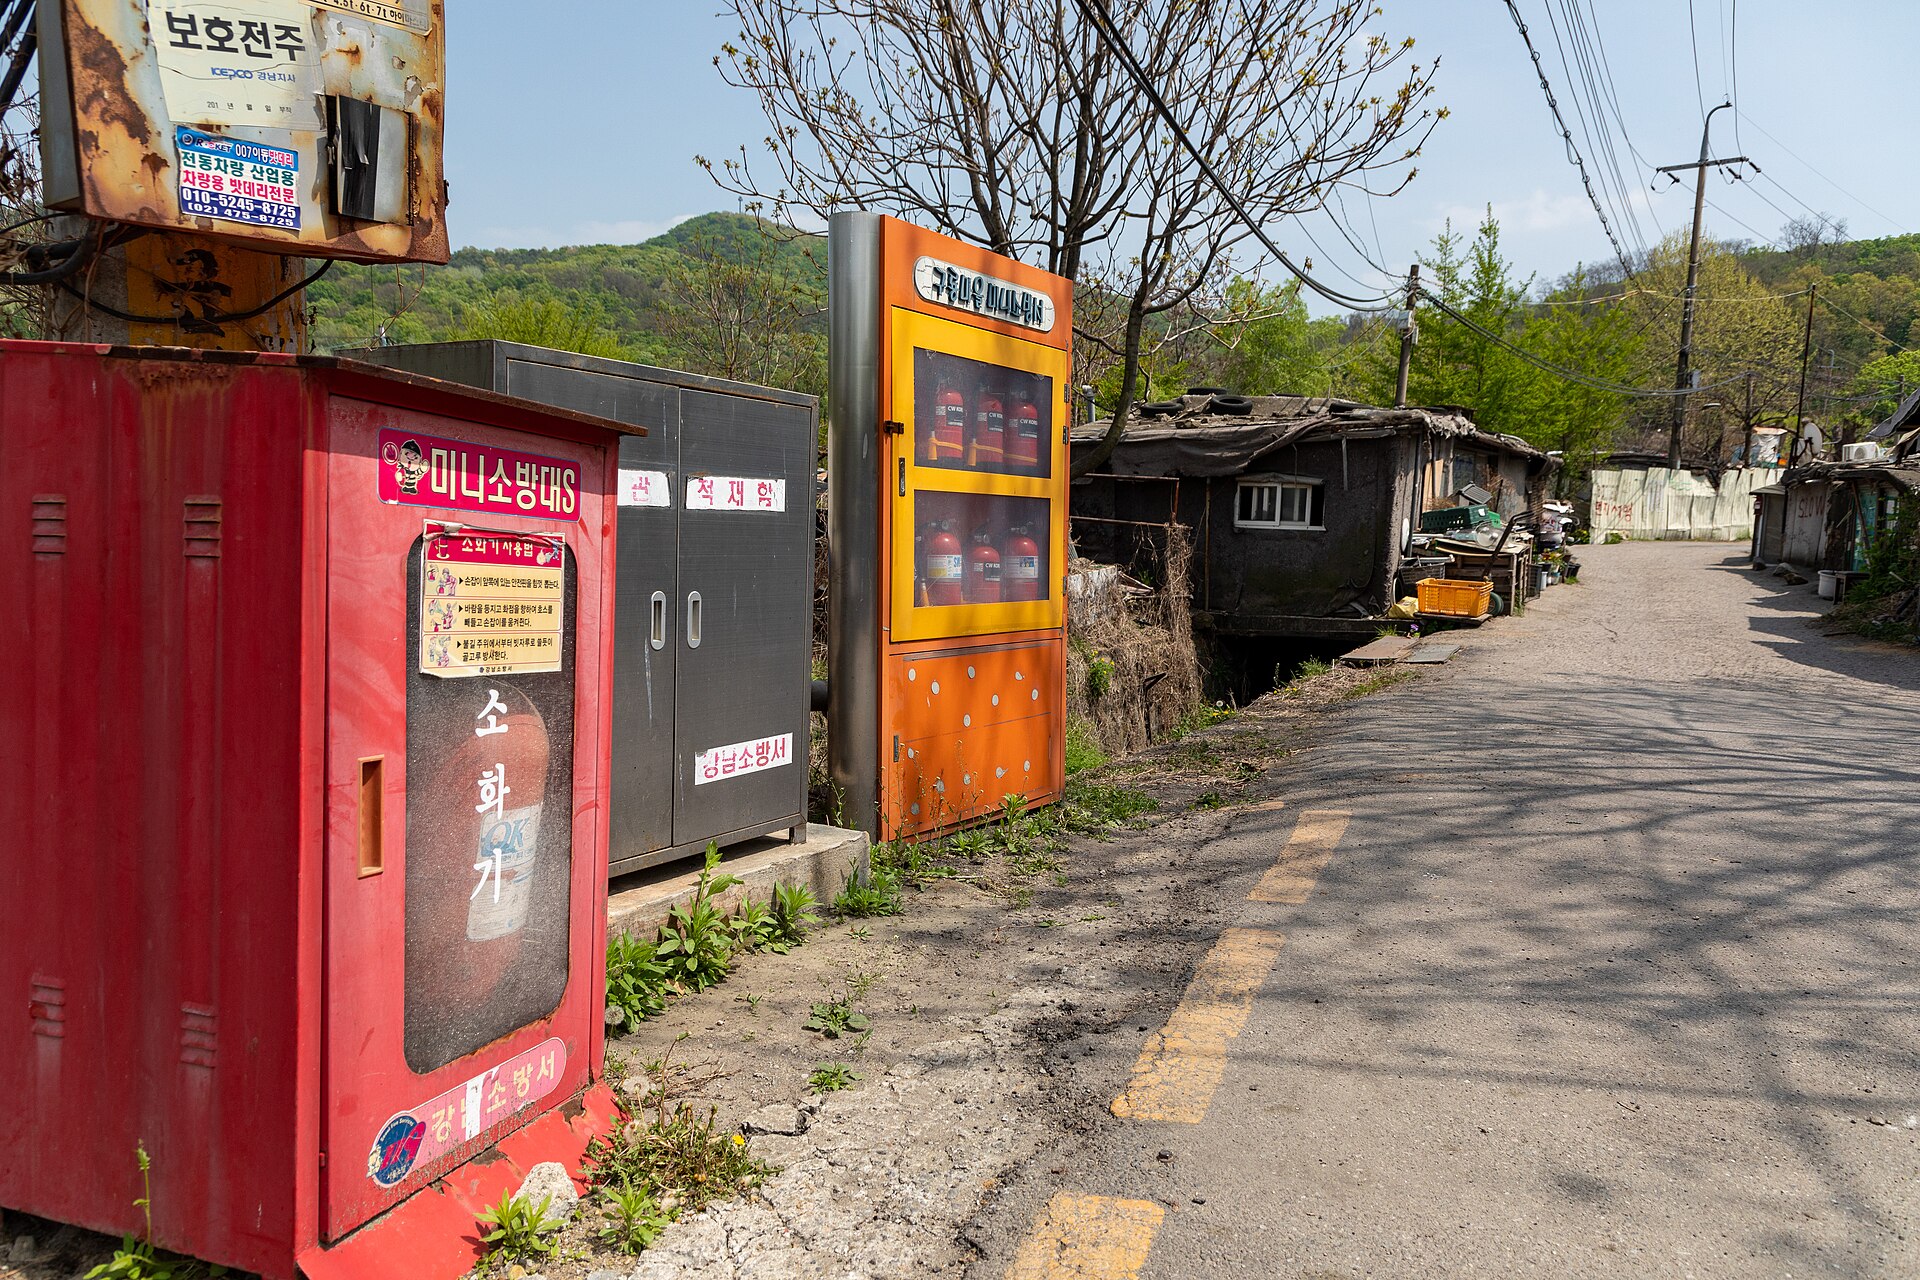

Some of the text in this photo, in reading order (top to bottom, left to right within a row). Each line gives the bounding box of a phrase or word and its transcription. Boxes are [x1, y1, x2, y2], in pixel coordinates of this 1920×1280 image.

[165, 11, 306, 62] 보호전주
[211, 67, 296, 83] KEPCO 강남지사
[206, 101, 219, 109] 201
[226, 102, 234, 110] 년
[181, 151, 294, 187] 전동차량 산업용
[182, 170, 294, 204] 차량용 밧데리전문
[182, 188, 296, 218] 010-5245-8725
[224, 208, 294, 227] 475-8725
[430, 447, 576, 514] 미니소방대S
[697, 479, 773, 507] 적재함
[1798, 496, 1825, 519] SLOW
[461, 537, 534, 557] 소화기 사용법
[464, 576, 482, 587] 손잡이
[464, 604, 483, 614] 바람을
[484, 604, 502, 614] 등지고
[520, 605, 537, 615] 향하여
[537, 605, 553, 614] 호스를
[483, 618, 507, 628] 손잡이를
[463, 639, 476, 649] 불길
[476, 638, 513, 649] 주위에서부터
[513, 638, 536, 648] 빗자루로
[462, 652, 481, 662] 골고루
[470, 688, 511, 905] 소화기
